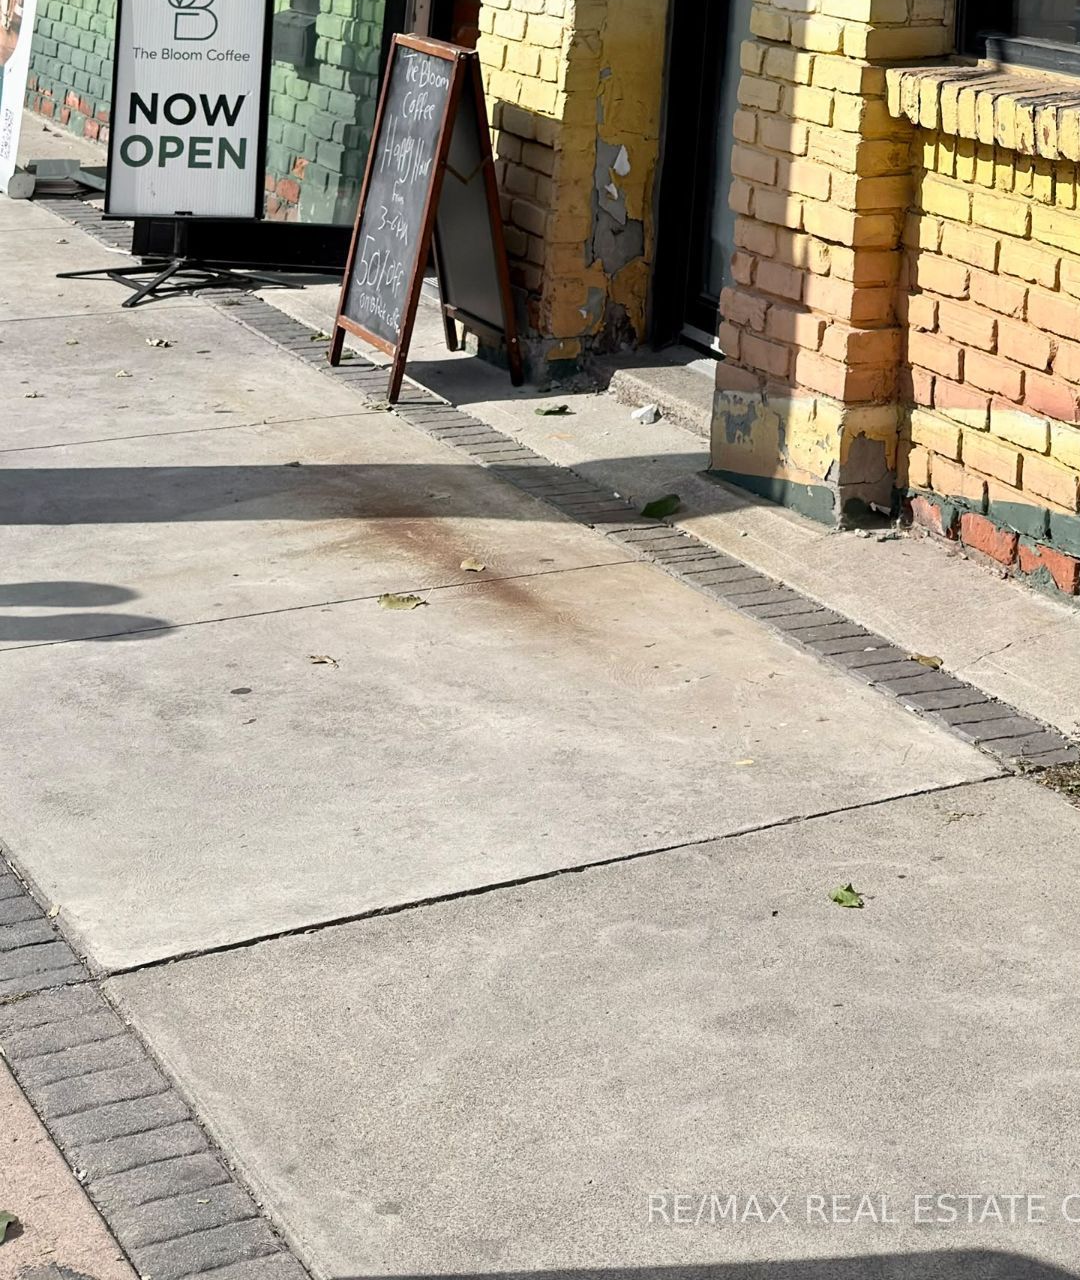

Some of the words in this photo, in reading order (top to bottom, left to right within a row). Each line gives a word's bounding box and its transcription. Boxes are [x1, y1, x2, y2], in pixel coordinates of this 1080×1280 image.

[132, 47, 157, 60] The
[161, 48, 202, 61] Bloom
[206, 49, 250, 62] Coffee
[419, 60, 449, 90] Bloom
[128, 92, 246, 127] NOW
[402, 91, 436, 121] Coffee
[120, 134, 247, 170] OPEN
[380, 113, 415, 184] Happy
